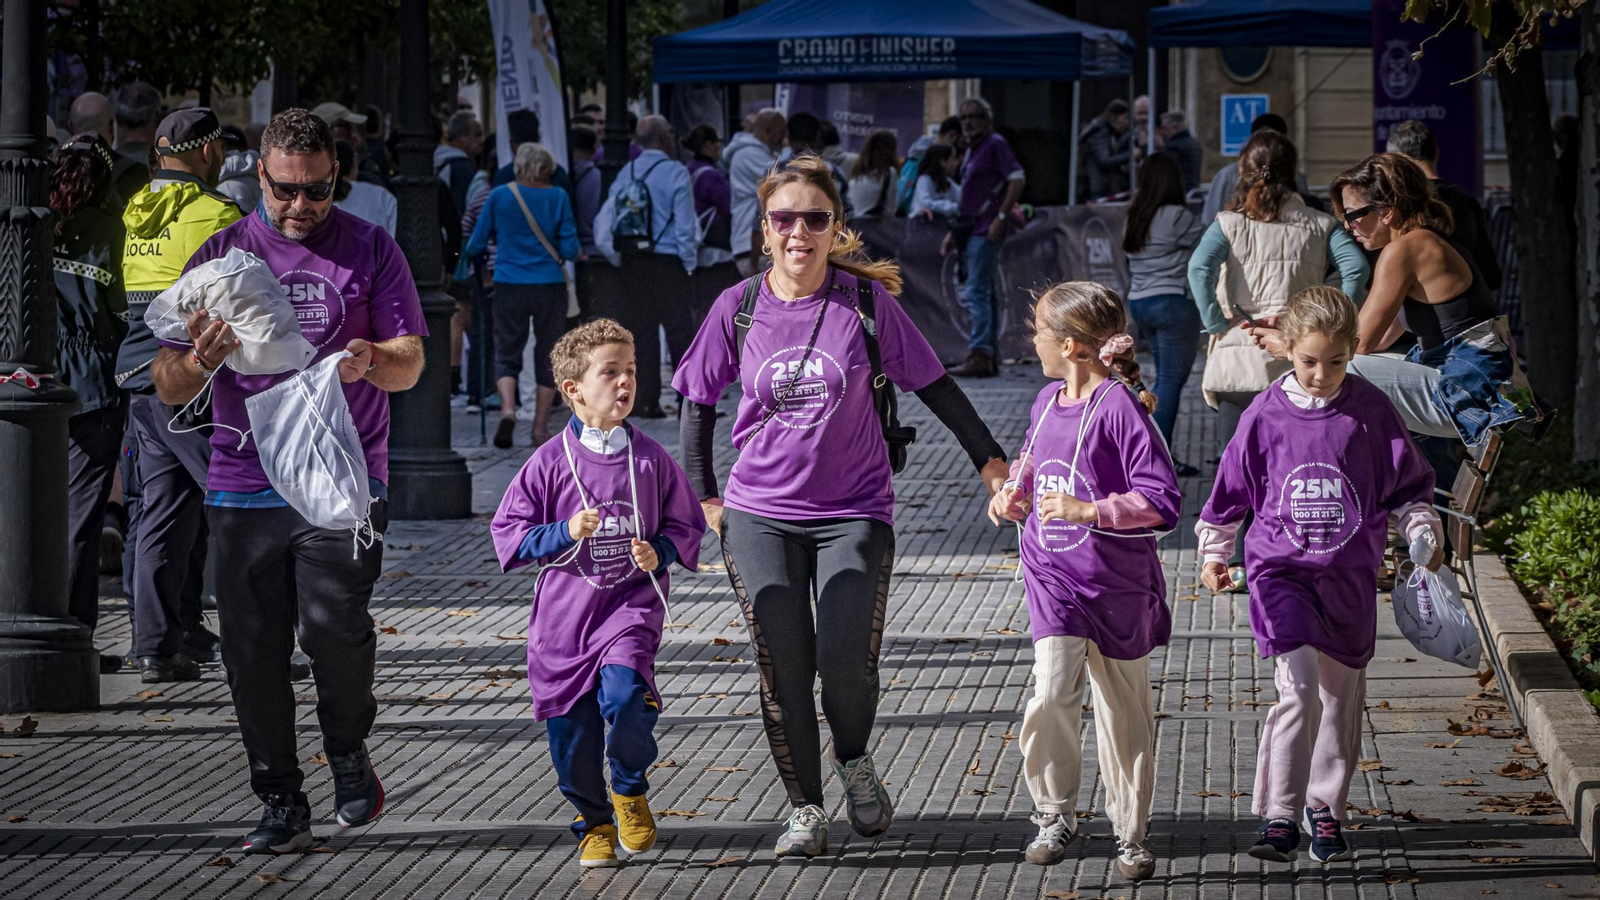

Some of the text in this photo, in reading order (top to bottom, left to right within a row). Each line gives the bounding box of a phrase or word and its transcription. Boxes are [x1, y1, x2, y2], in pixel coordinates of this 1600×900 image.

[778, 37, 957, 64] CRONOFINISHER
[1229, 100, 1261, 124] AT
[127, 243, 162, 257] LOCAL
[280, 283, 326, 301] 25N
[770, 357, 824, 381] 25N
[1037, 474, 1075, 498] 25N
[1290, 478, 1342, 499] 25N
